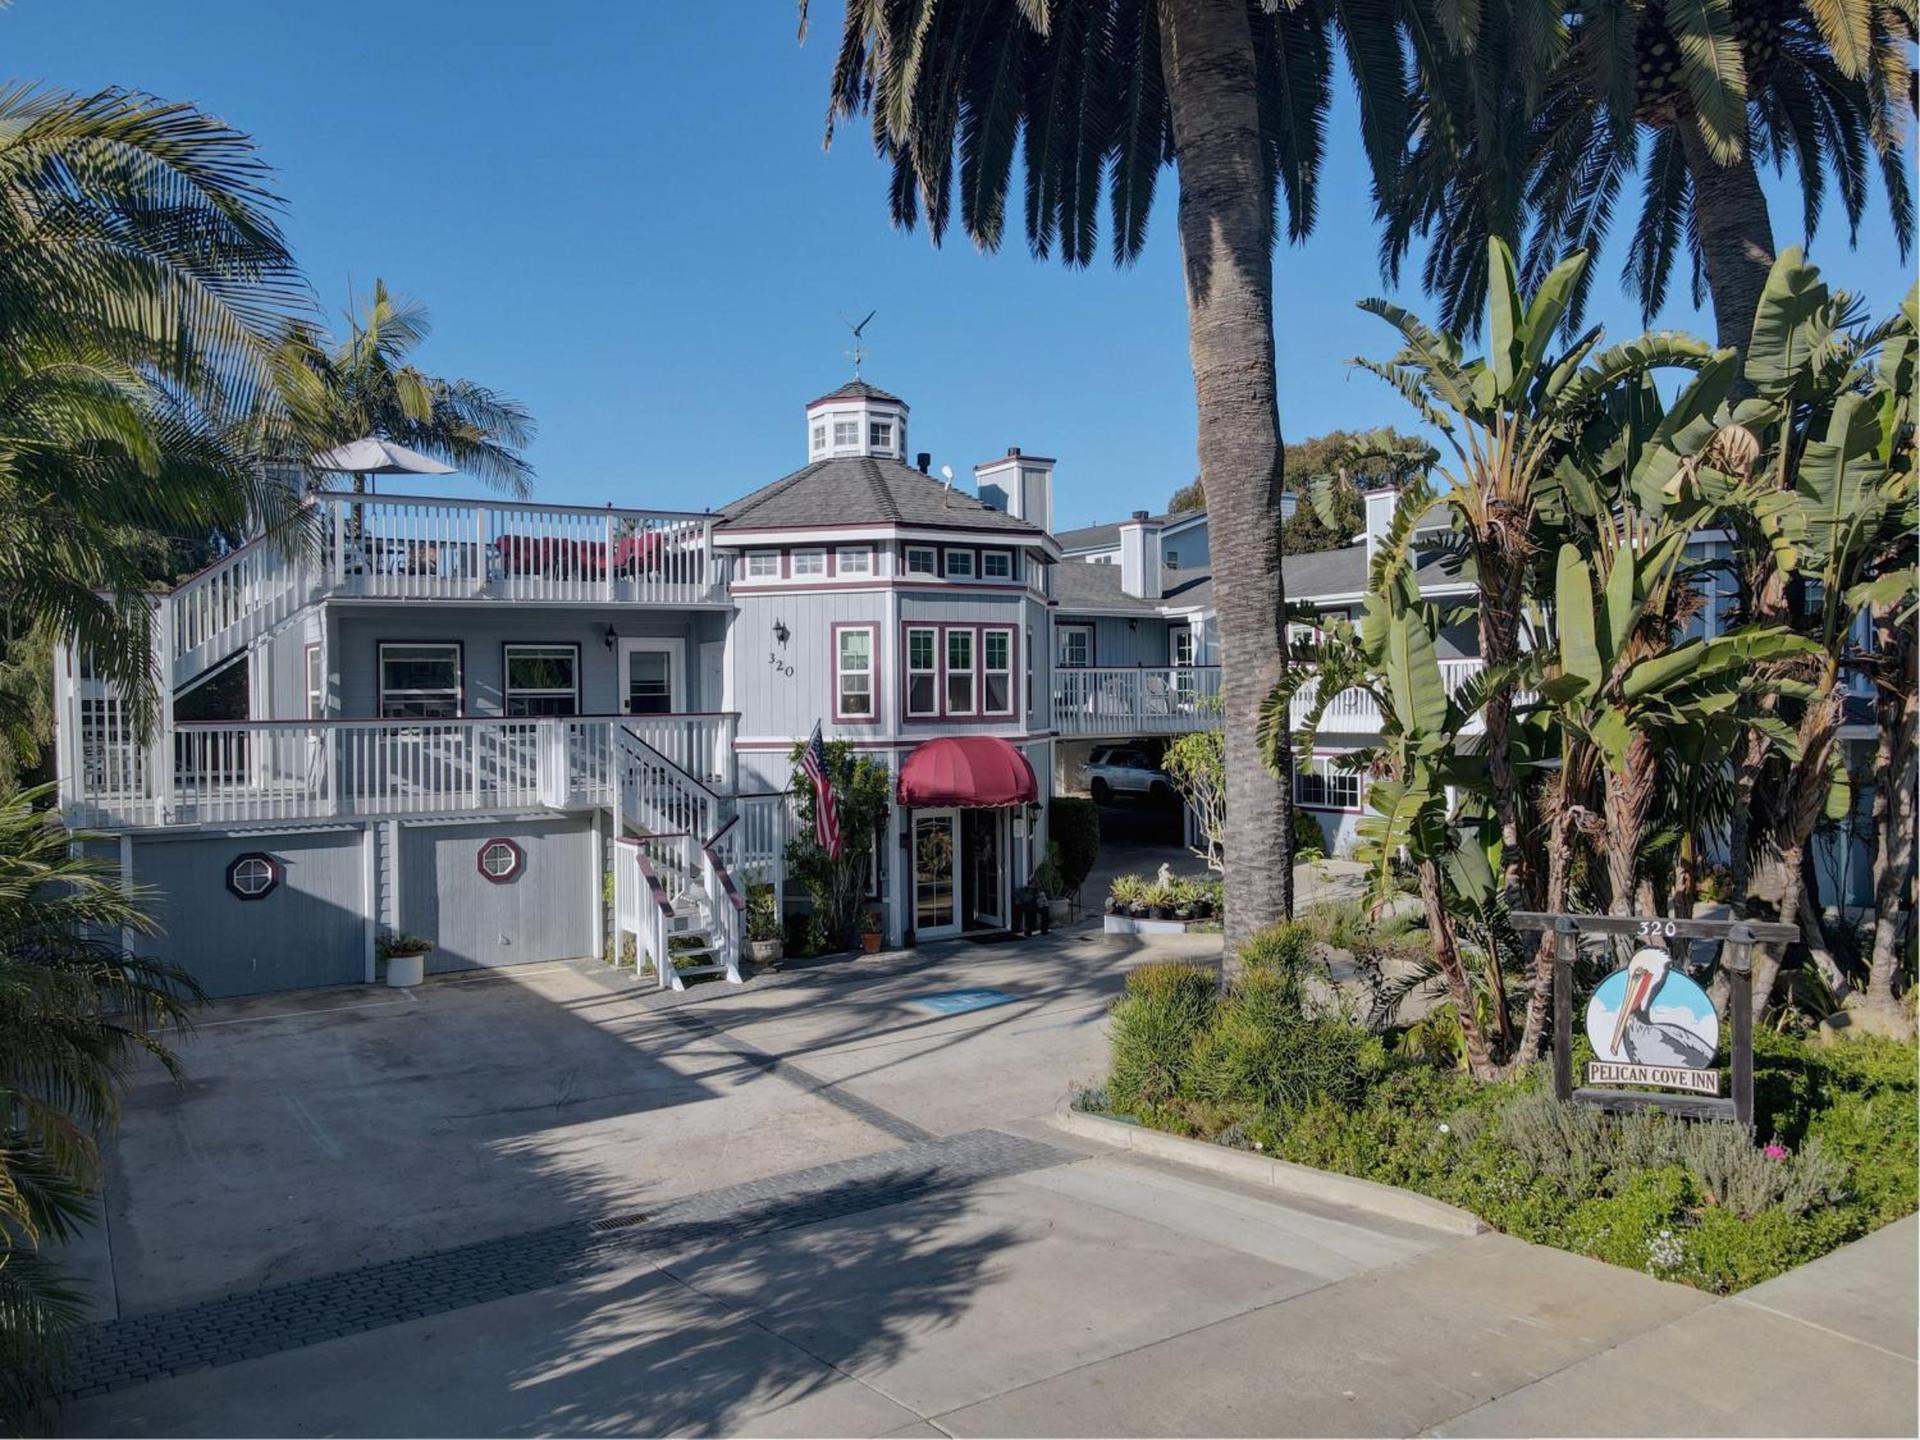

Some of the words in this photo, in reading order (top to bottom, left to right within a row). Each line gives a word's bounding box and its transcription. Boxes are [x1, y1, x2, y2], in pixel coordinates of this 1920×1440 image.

[768, 652, 794, 677] 320
[1637, 921, 1676, 937] 320
[1591, 1065, 1648, 1081] PELICAN
[1652, 1069, 1687, 1085] COVE
[1691, 1073, 1715, 1090] INN
